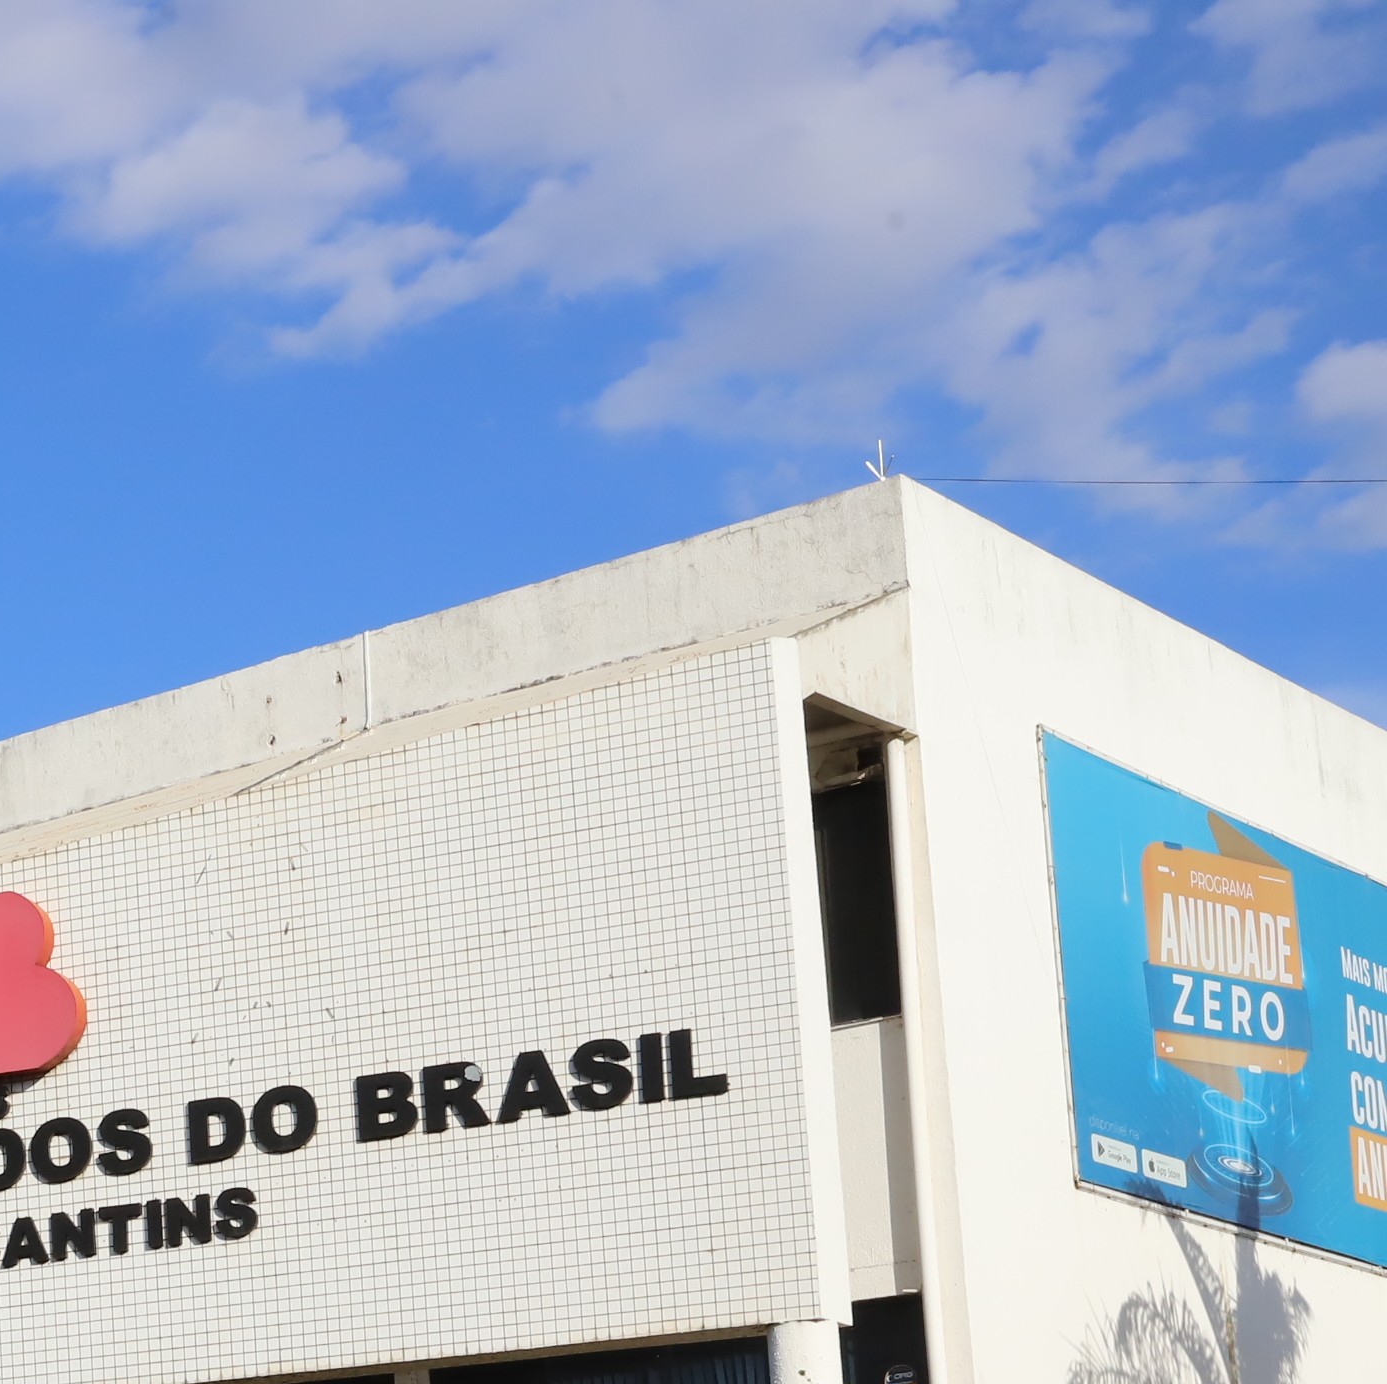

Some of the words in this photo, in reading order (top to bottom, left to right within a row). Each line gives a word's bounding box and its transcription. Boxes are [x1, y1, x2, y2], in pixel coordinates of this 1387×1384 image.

[1190, 870, 1254, 901] PROGRAMA
[1160, 892, 1294, 985] ANUIDADE
[1340, 946, 1371, 988] MAIS
[1172, 973, 1285, 1041] ZERO
[187, 1085, 318, 1166] DO
[356, 1028, 729, 1143] BRASIL
[1107, 1149, 1123, 1162] Google
[1157, 1165, 1167, 1177] App
[1357, 1136, 1387, 1201] AN
